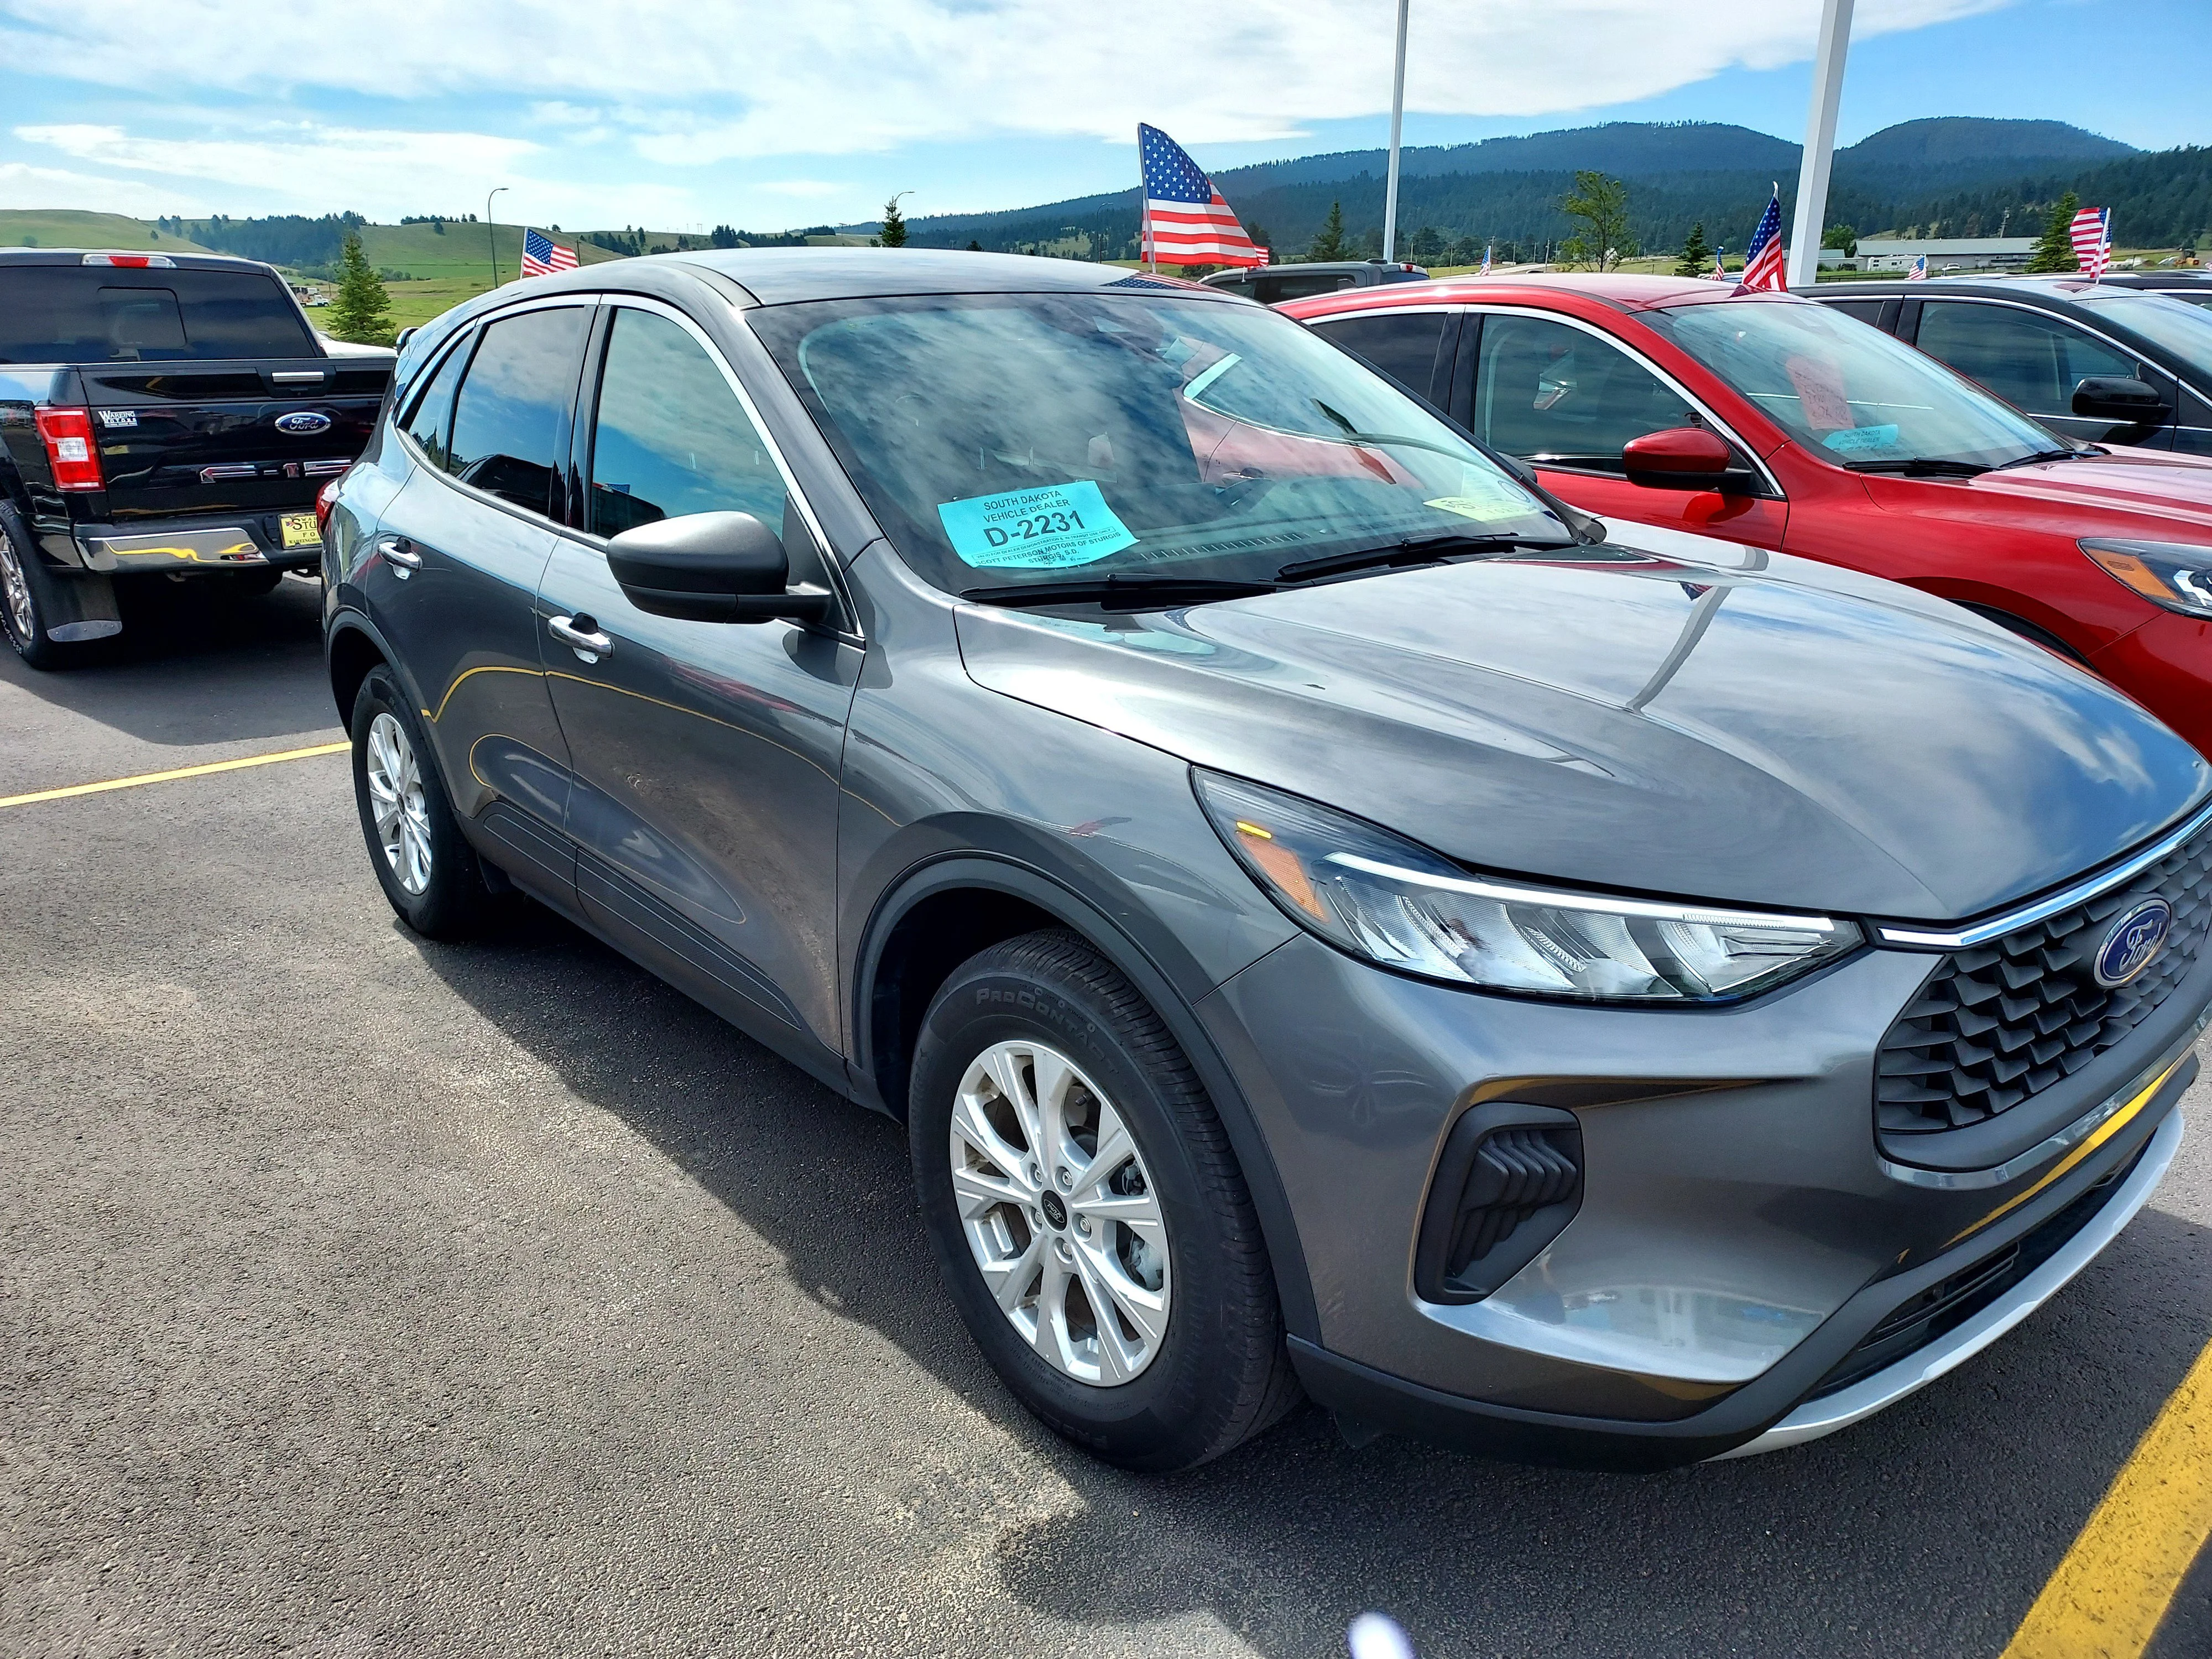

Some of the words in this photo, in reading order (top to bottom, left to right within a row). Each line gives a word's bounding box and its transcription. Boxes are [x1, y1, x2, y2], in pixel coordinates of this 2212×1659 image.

[289, 417, 319, 430] Ford
[200, 459, 352, 484] F-15
[983, 499, 1019, 510] SOUTH
[1020, 491, 1062, 504] DAKOTA
[983, 508, 1028, 523] VEHICLE
[1029, 499, 1071, 513] DEALER
[983, 510, 1086, 547] D-2231
[1002, 548, 1044, 562] PETERSON
[1044, 541, 1077, 552] MOTORS
[1088, 532, 1121, 544] STURGIS
[1021, 537, 1060, 550] DEMONSTRATION
[2119, 919, 2162, 972] Ford
